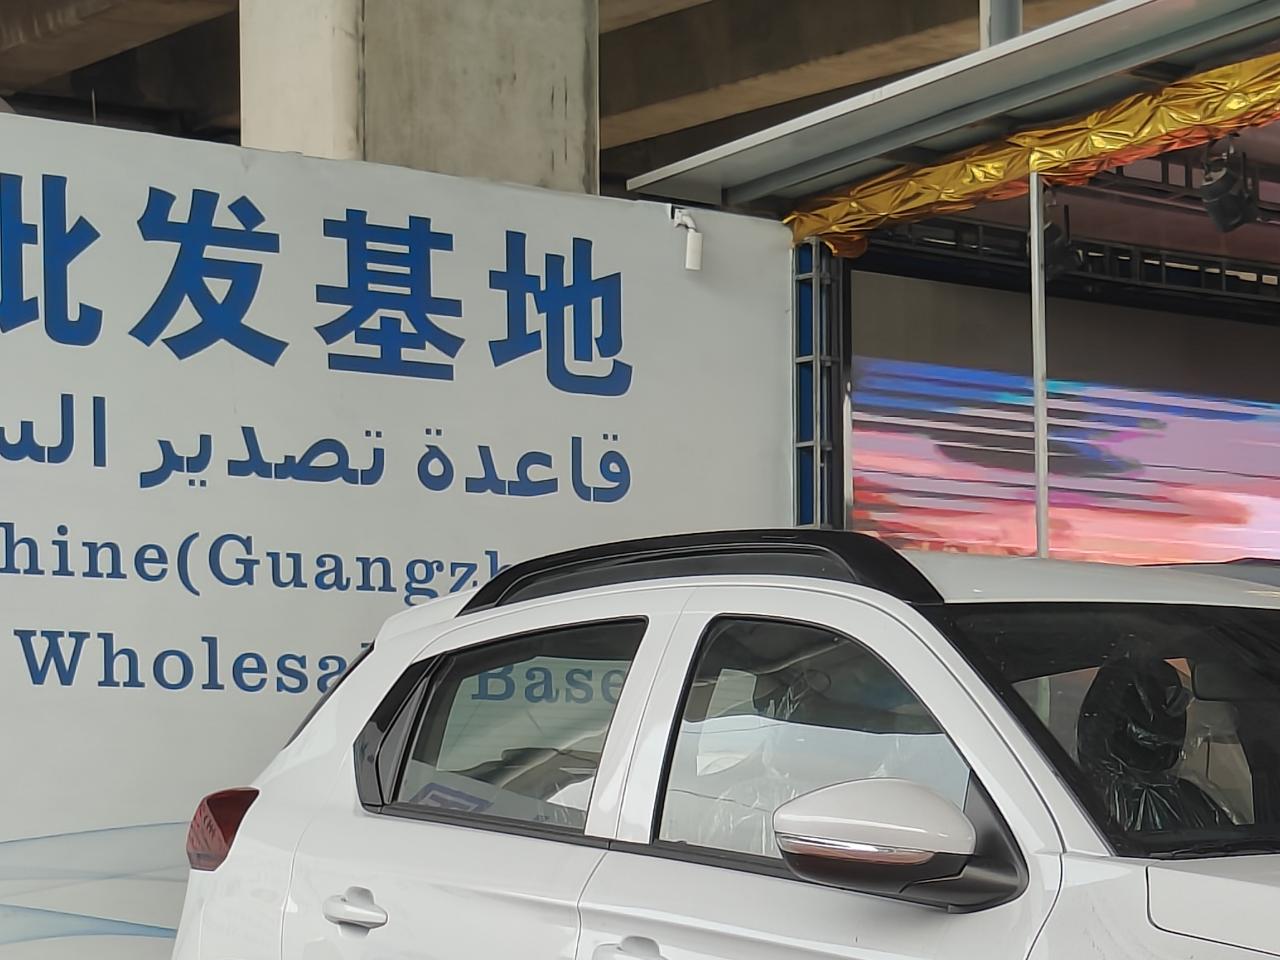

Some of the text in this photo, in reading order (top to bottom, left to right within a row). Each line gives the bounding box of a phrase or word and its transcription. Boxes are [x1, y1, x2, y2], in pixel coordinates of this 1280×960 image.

[0, 173, 633, 396] 批发基地
[139, 425, 385, 488] تصدير
[416, 427, 631, 502] قاعدة
[14, 629, 373, 694] Wholesa
